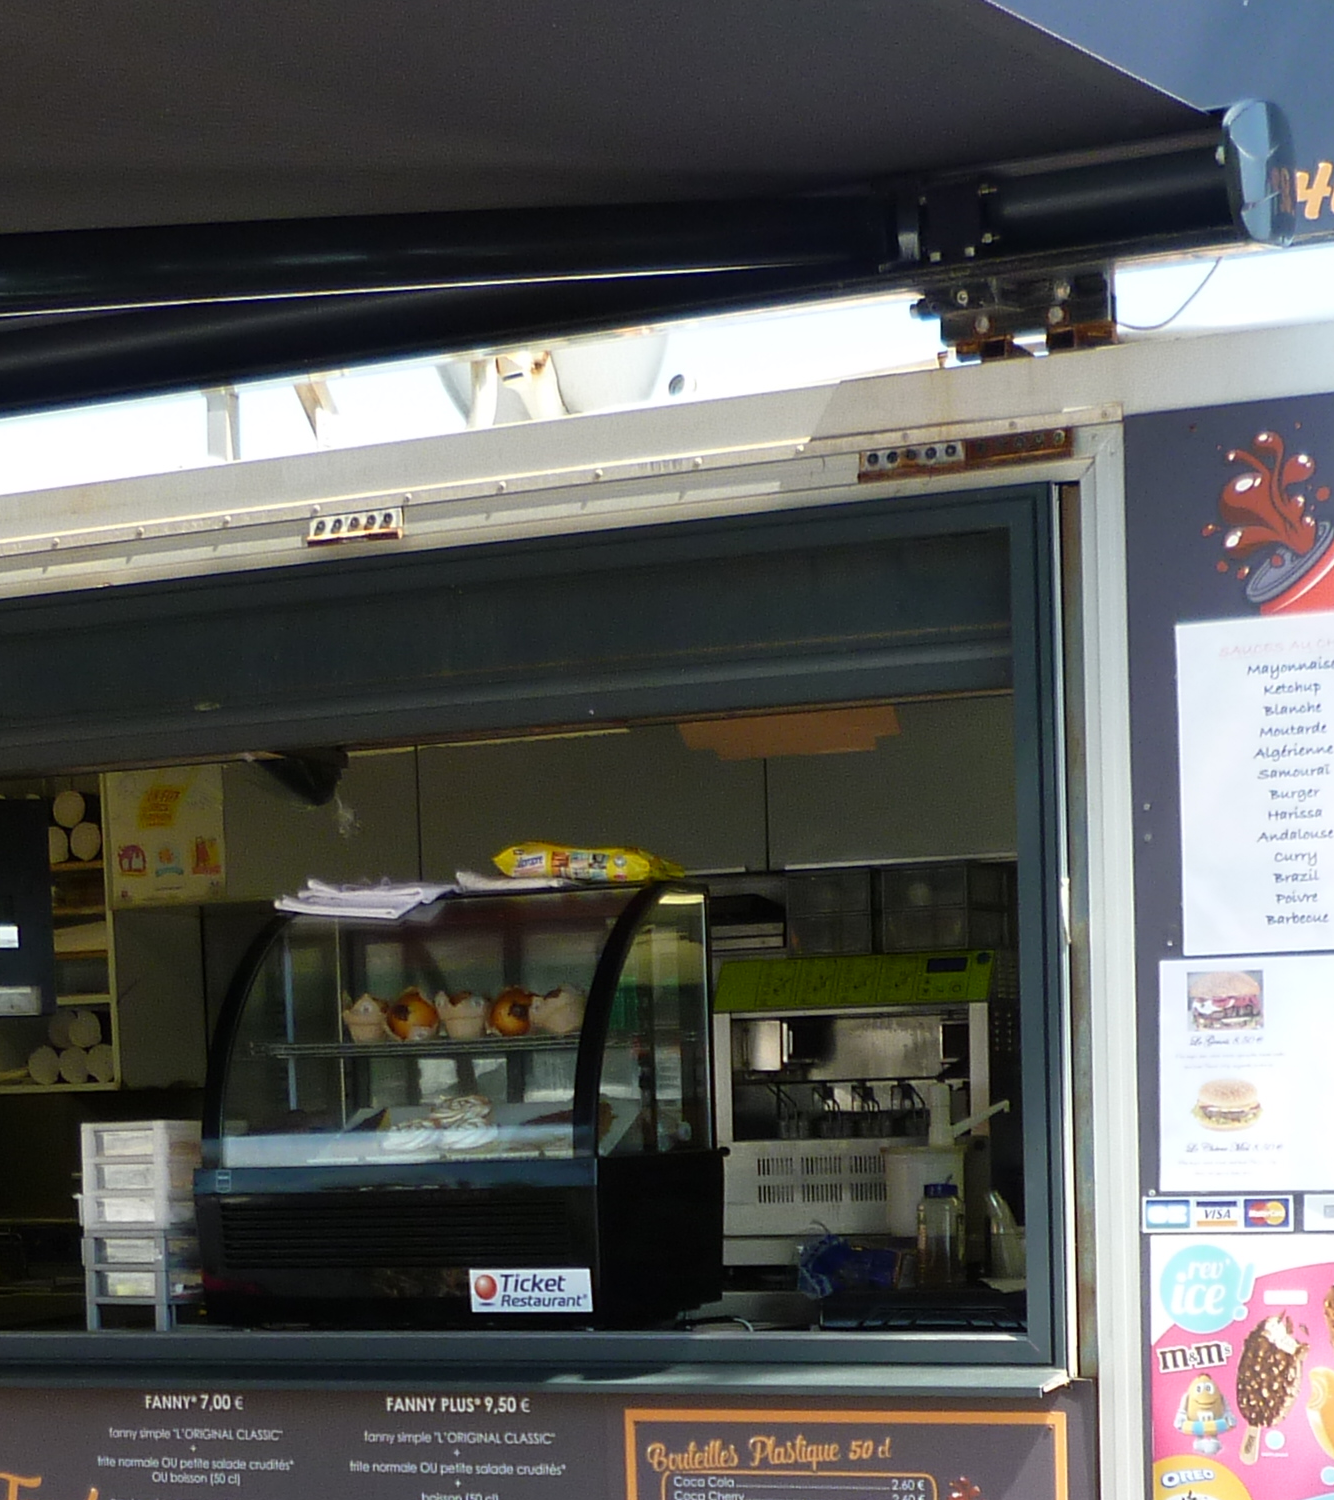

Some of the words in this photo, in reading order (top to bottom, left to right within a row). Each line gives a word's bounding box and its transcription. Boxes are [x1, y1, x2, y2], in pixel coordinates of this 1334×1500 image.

[1263, 681, 1322, 696] Ketchup
[1262, 701, 1323, 716] Blanche
[1259, 722, 1328, 737] Moutarde
[1253, 743, 1334, 760] Algérienne
[1257, 764, 1332, 780] Samouraï
[1269, 787, 1320, 802] Burger
[1268, 807, 1323, 821] Harissa
[1256, 827, 1334, 843] Andalouse
[1274, 850, 1318, 866] Curry
[1273, 869, 1320, 884] Brazil
[1275, 891, 1319, 904] Poivre
[1266, 911, 1330, 926] Barbecue
[1203, 1207, 1232, 1220] VISA
[500, 1273, 566, 1293] Ticket
[500, 1294, 583, 1308] Restaurant
[199, 1394, 232, 1414] 7,00
[233, 1395, 244, 1412] €
[385, 1395, 438, 1415] FANNY
[483, 1396, 517, 1417] 9,50
[518, 1397, 531, 1415] €
[646, 1442, 739, 1473] Bouteilles
[749, 1434, 842, 1471] Plastique
[848, 1439, 875, 1461] 50
[877, 1437, 893, 1460] cl
[673, 1475, 705, 1490] Coca
[1162, 1470, 1215, 1487] OREO
